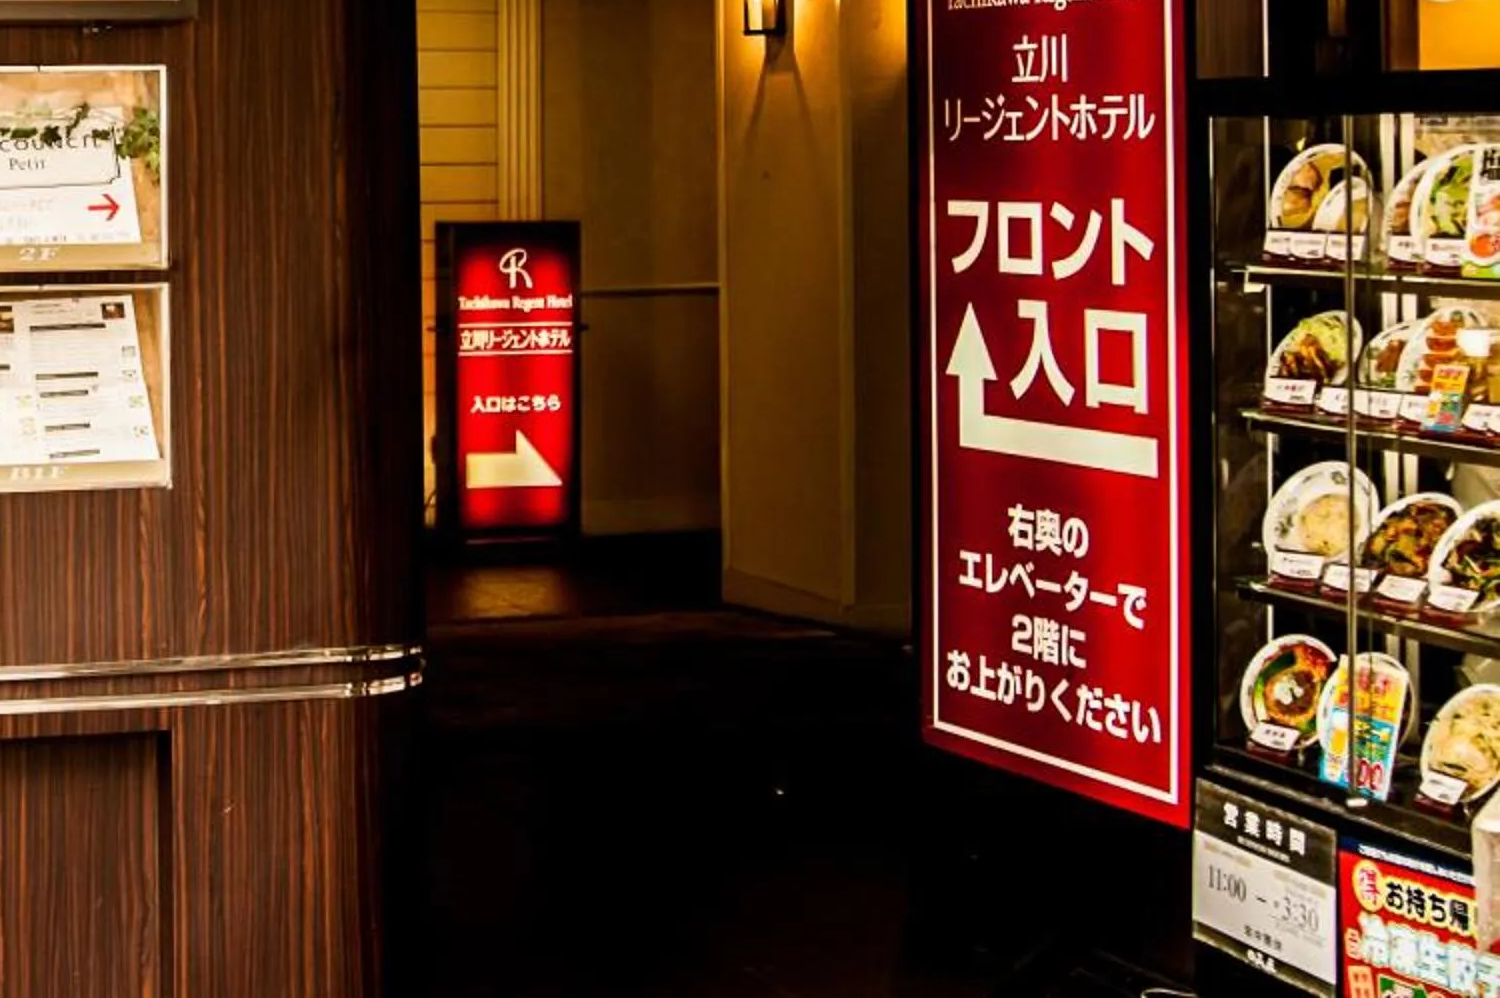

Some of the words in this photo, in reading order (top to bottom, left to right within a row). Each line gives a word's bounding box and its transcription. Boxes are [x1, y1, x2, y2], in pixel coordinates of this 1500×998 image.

[1012, 34, 1069, 82] 立川
[945, 94, 1155, 141] リージェントホテル
[948, 198, 1154, 285] フロント
[460, 328, 571, 350] 立川リージェントホテル
[1009, 299, 1148, 414] 入口
[470, 395, 561, 414] 入口はこちら
[1008, 503, 1089, 559] 右奥の
[959, 550, 1147, 629] エレベーターで
[1011, 614, 1086, 669] 2階に
[946, 650, 1162, 743] お上がりください
[1385, 880, 1479, 933] お持ち帰
